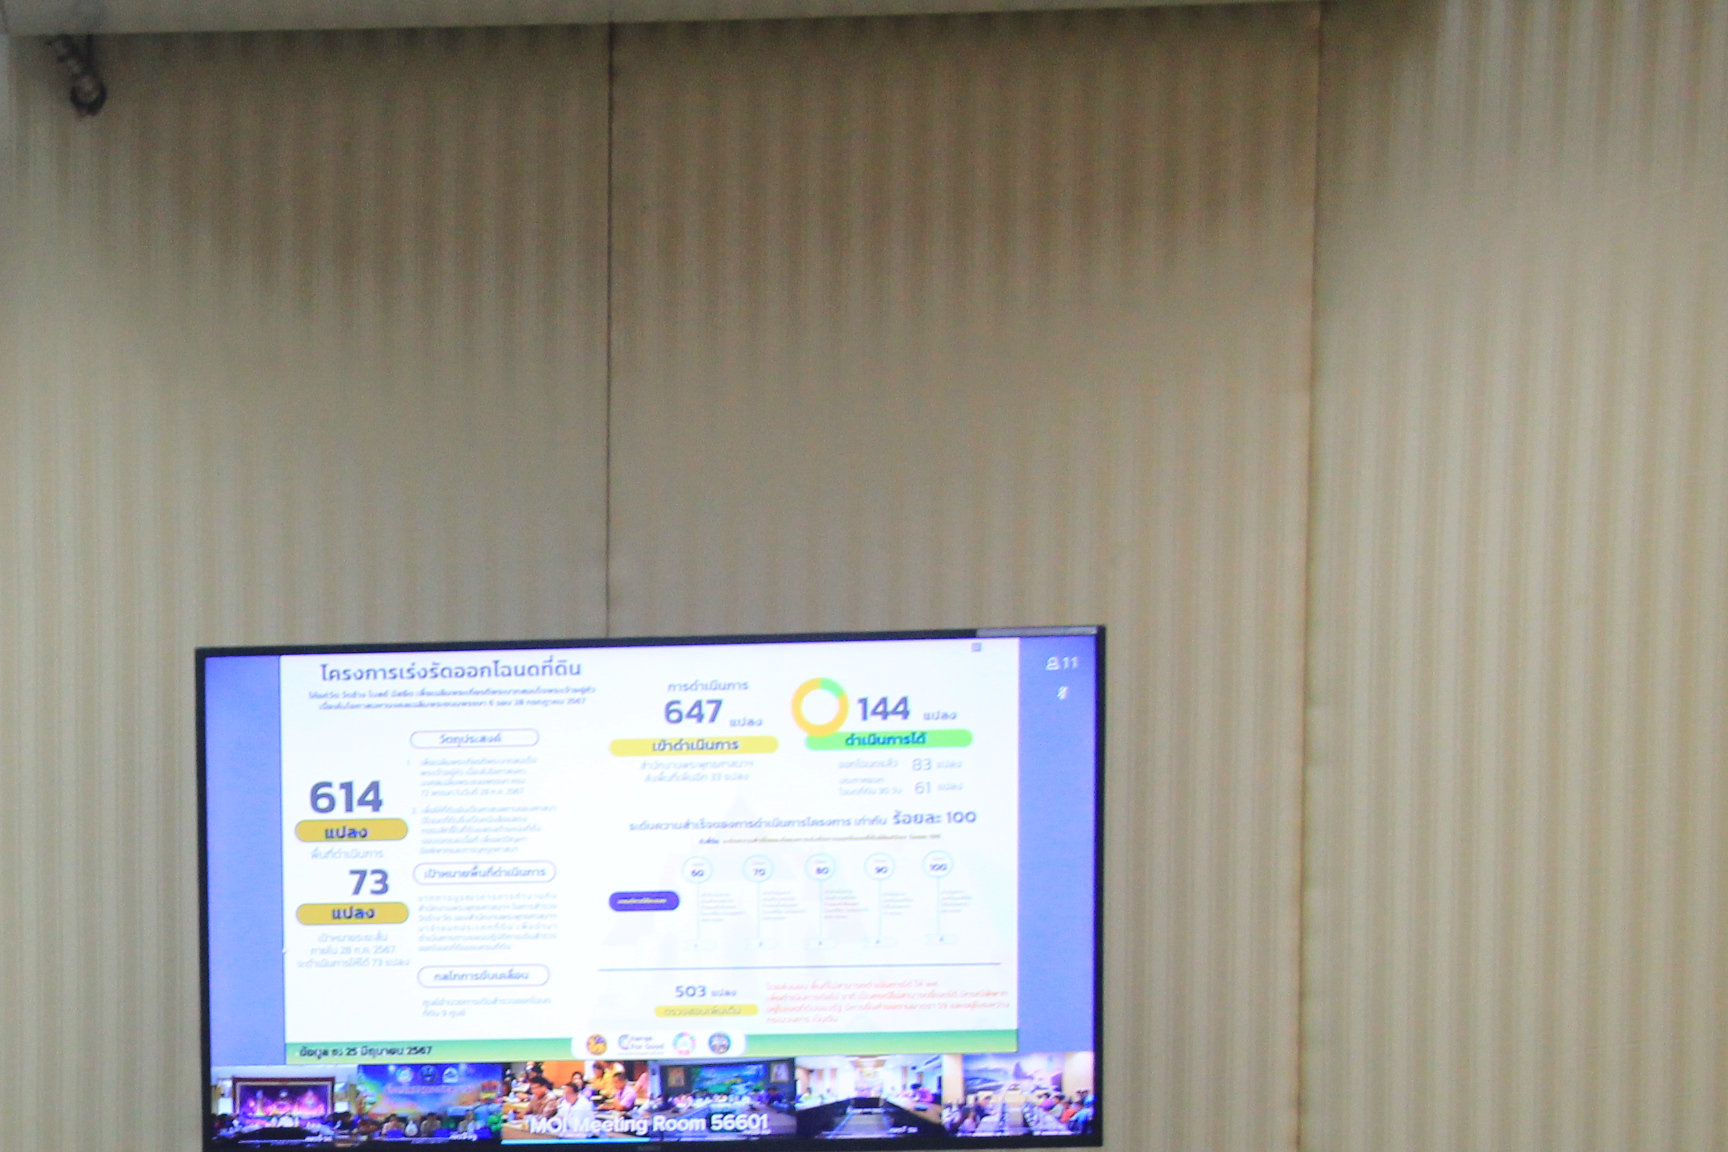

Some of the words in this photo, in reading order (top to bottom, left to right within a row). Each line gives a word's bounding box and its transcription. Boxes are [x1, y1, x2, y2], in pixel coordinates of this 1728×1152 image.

[321, 655, 582, 682] โครงการเร่งรัดออกโฉนดที่ดิน
[667, 679, 749, 693] การดำเนินการ
[664, 699, 722, 724] 647
[857, 695, 911, 721] 144
[912, 757, 933, 771] 83
[914, 781, 932, 795] 61
[309, 780, 383, 813] 614
[893, 809, 942, 825] ร้อยละ
[946, 810, 977, 824] 100
[325, 825, 368, 840] แปลง
[349, 869, 390, 895] 73
[332, 906, 376, 920] แปลง
[675, 985, 707, 997] 503
[530, 1118, 568, 1134] MOI
[573, 1116, 647, 1138] Meeting
[652, 1116, 705, 1133] Room
[709, 1113, 770, 1132] 56601
